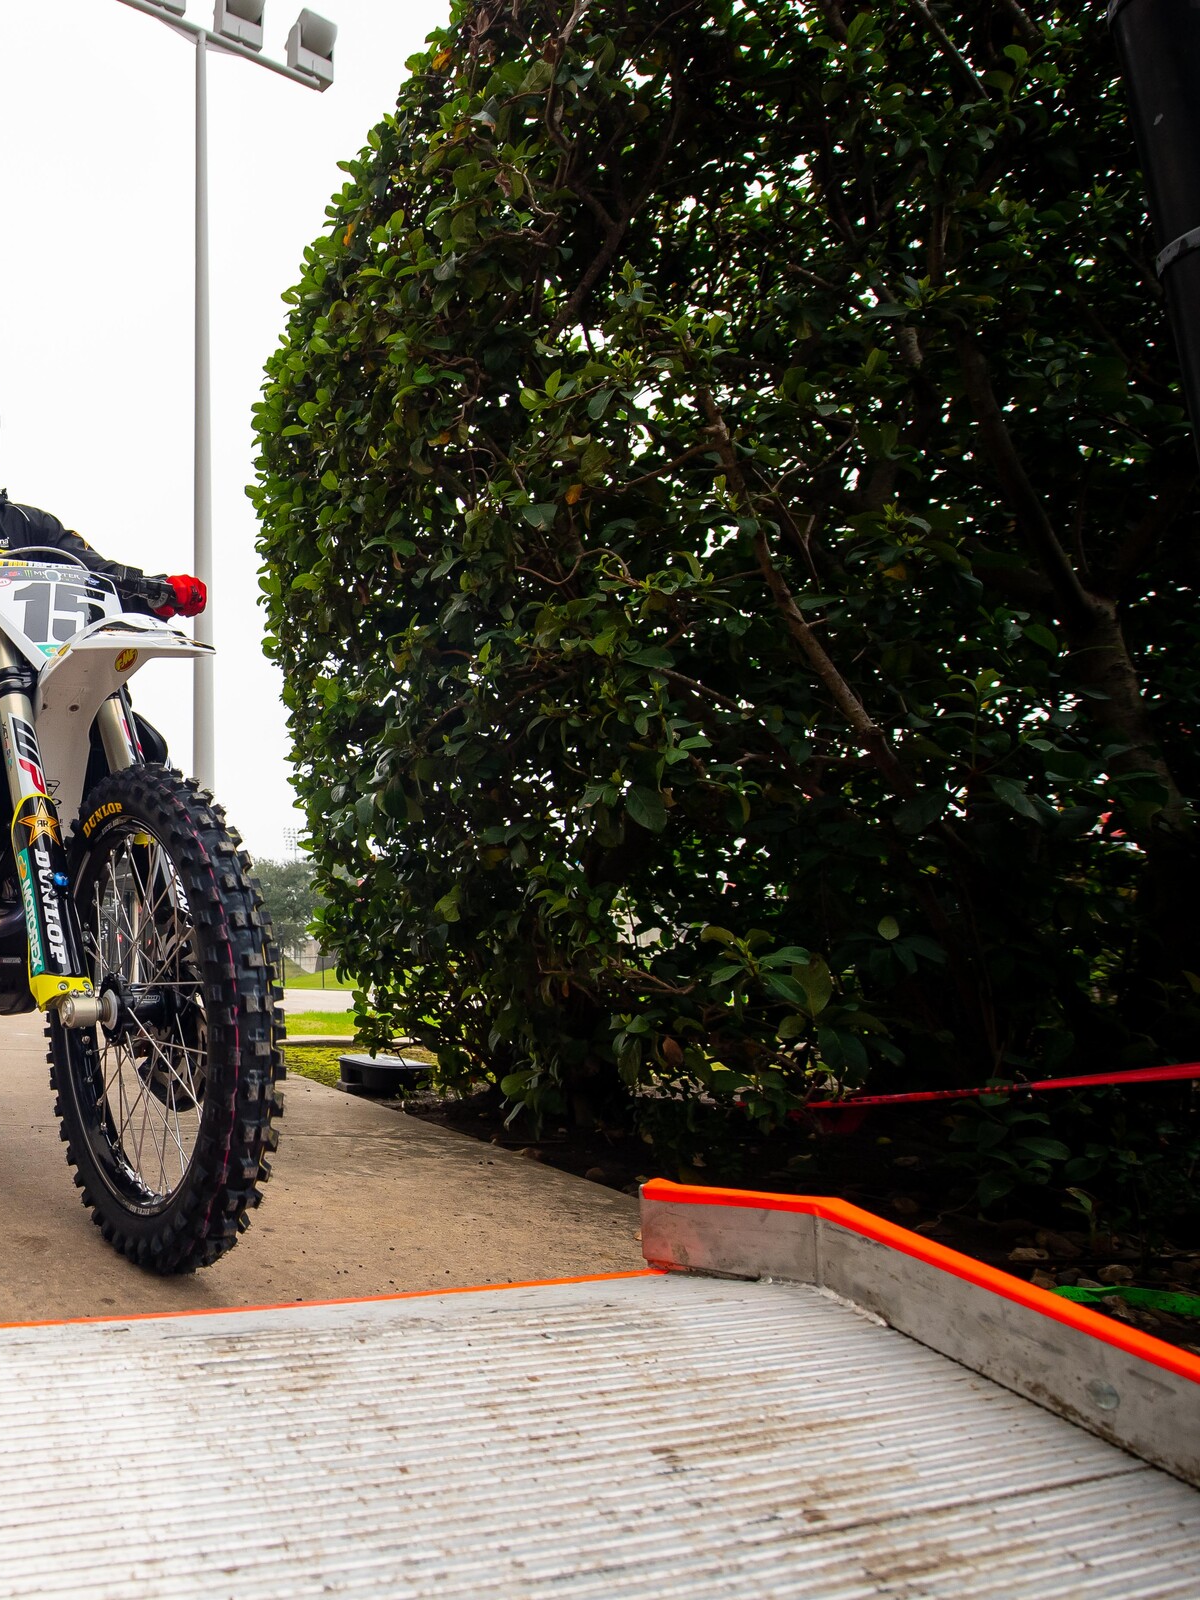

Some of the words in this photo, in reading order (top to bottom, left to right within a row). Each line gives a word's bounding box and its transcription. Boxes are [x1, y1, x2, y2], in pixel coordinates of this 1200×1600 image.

[13, 583, 105, 642] 15
[116, 648, 138, 671] FMF
[81, 802, 123, 838] DUNLOP
[22, 878, 43, 972] MOTOREX
[34, 848, 68, 965] DUNLOP
